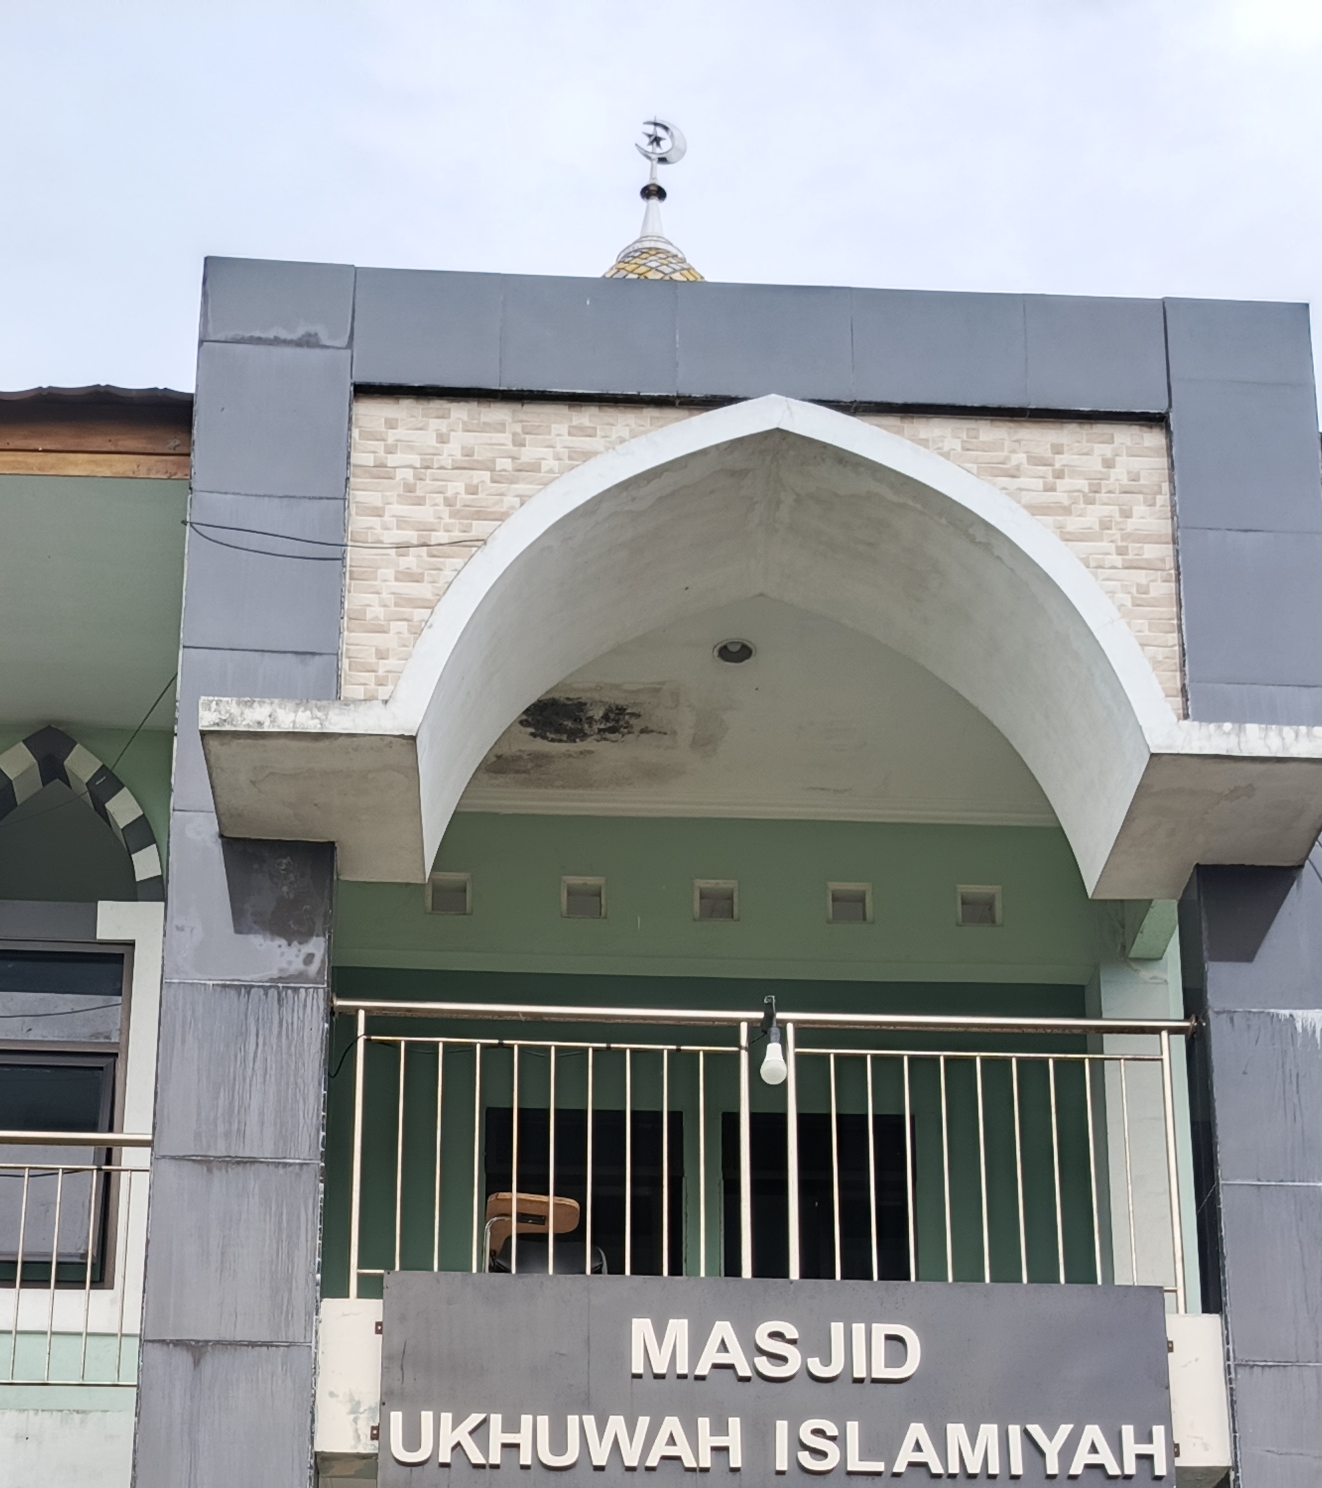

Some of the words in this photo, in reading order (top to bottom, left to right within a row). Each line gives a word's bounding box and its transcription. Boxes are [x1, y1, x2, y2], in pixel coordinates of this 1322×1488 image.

[630, 1317, 922, 1383] MASJID
[388, 1410, 744, 1470] UKHUWAH
[774, 1418, 1168, 1478] ISLAMIYAH
